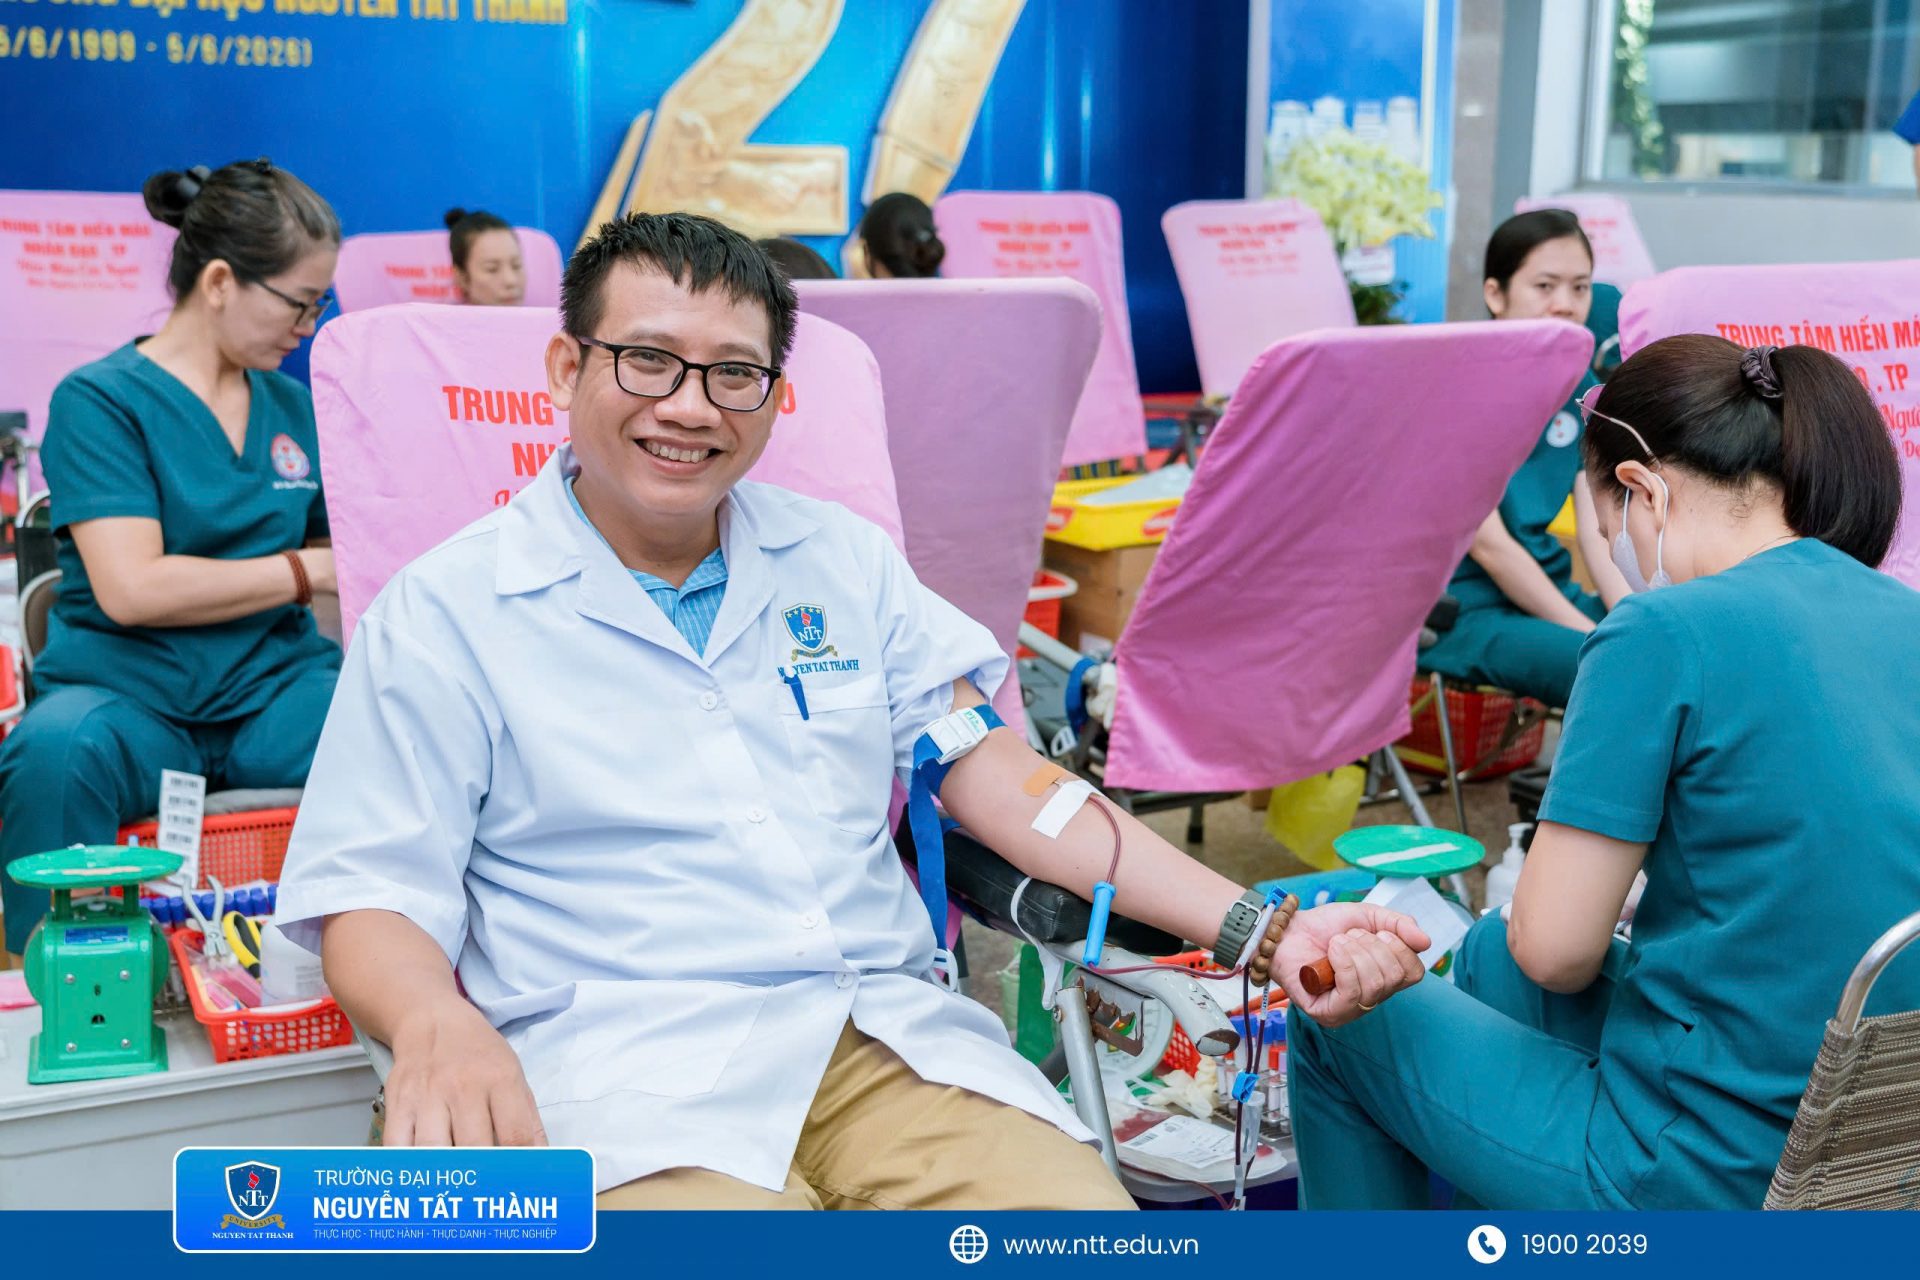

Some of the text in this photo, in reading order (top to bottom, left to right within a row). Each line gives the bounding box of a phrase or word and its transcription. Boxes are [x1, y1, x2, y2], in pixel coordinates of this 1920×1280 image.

[1838, 315, 1888, 352] HIẾN
[1893, 314, 1920, 349] MÁ
[1883, 363, 1908, 391] TP
[442, 385, 554, 426] TRUNG
[798, 625, 823, 642] NTT
[778, 659, 859, 677] NYEN TAT THANH
